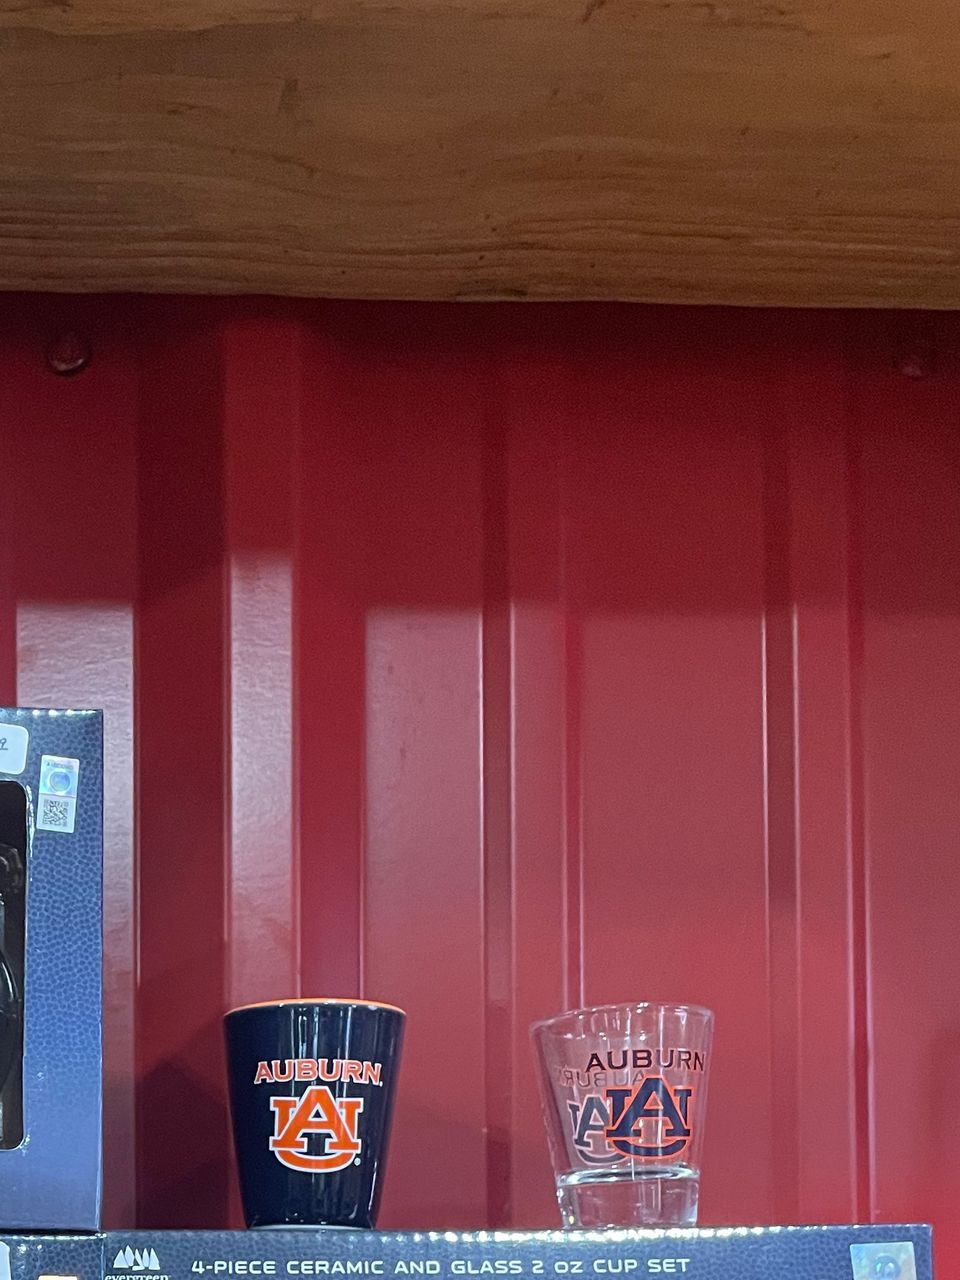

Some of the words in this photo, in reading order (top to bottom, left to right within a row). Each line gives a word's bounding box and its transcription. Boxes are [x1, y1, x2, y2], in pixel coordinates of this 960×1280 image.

[253, 1058, 383, 1087] AUBURN
[585, 1048, 705, 1074] AUBURN
[191, 1259, 276, 1275] 4-PIECE
[286, 1260, 385, 1275] CERAMIC
[394, 1259, 441, 1275] AND
[451, 1259, 523, 1274] GLASS
[531, 1259, 545, 1274] 2
[593, 1259, 638, 1274] CUP
[647, 1258, 691, 1273] SET
